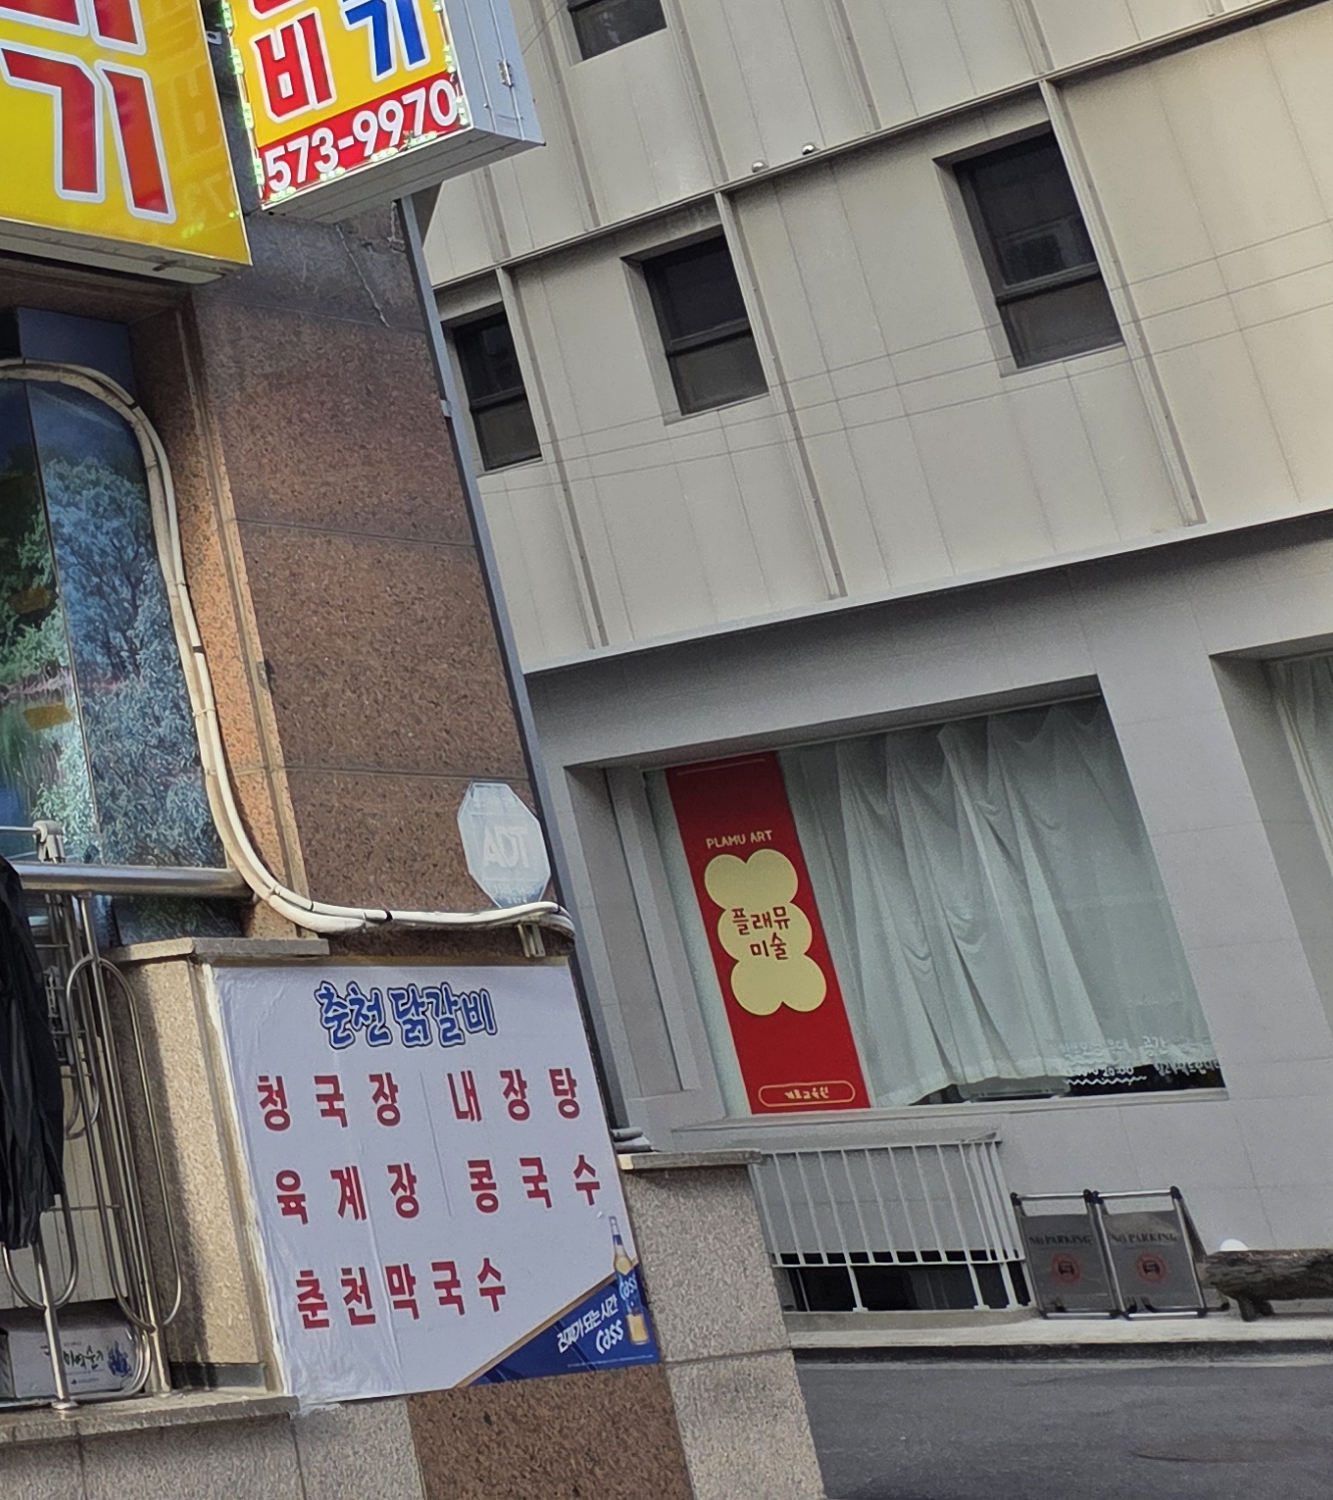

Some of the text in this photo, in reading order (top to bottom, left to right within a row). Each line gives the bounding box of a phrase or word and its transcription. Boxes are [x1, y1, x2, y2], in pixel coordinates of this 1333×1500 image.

[264, 76, 458, 194] 573-9970
[482, 826, 530, 868] ADT
[706, 830, 773, 848] PLAMU ART
[732, 906, 790, 935] 플래뮤
[750, 932, 788, 960] 미술
[315, 980, 498, 1049] 춘천 닭갈비
[256, 1067, 580, 1132] 청국장 내장탕
[276, 1155, 601, 1225] 육계장 콩국수
[1045, 1234, 1093, 1245] PARKING
[1128, 1232, 1178, 1243] PARKING
[296, 1258, 507, 1330] 춘천막국수
